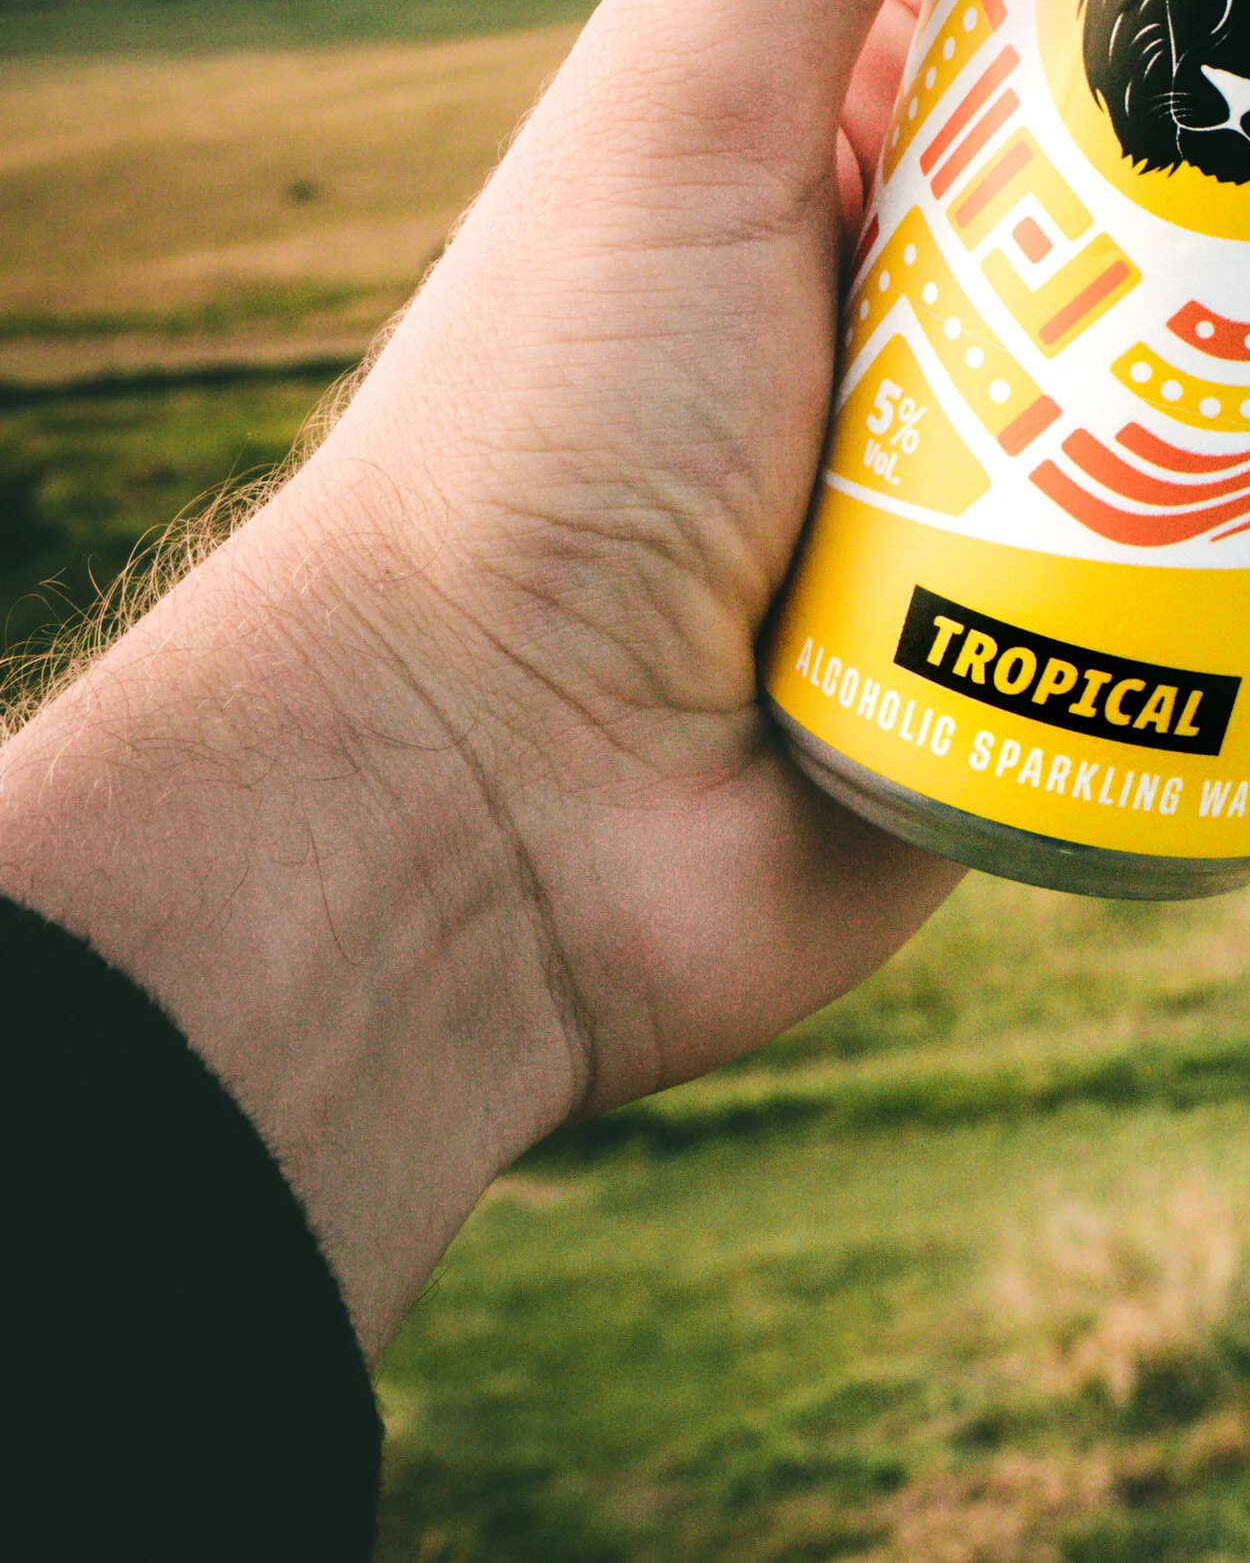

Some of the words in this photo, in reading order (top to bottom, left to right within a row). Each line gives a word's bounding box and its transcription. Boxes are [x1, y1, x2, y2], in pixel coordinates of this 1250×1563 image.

[865, 377, 929, 455] 5%
[794, 637, 957, 757] ALCOHOLIC
[967, 729, 1184, 816] SPARKLING
[926, 614, 1204, 738] TROPICAL
